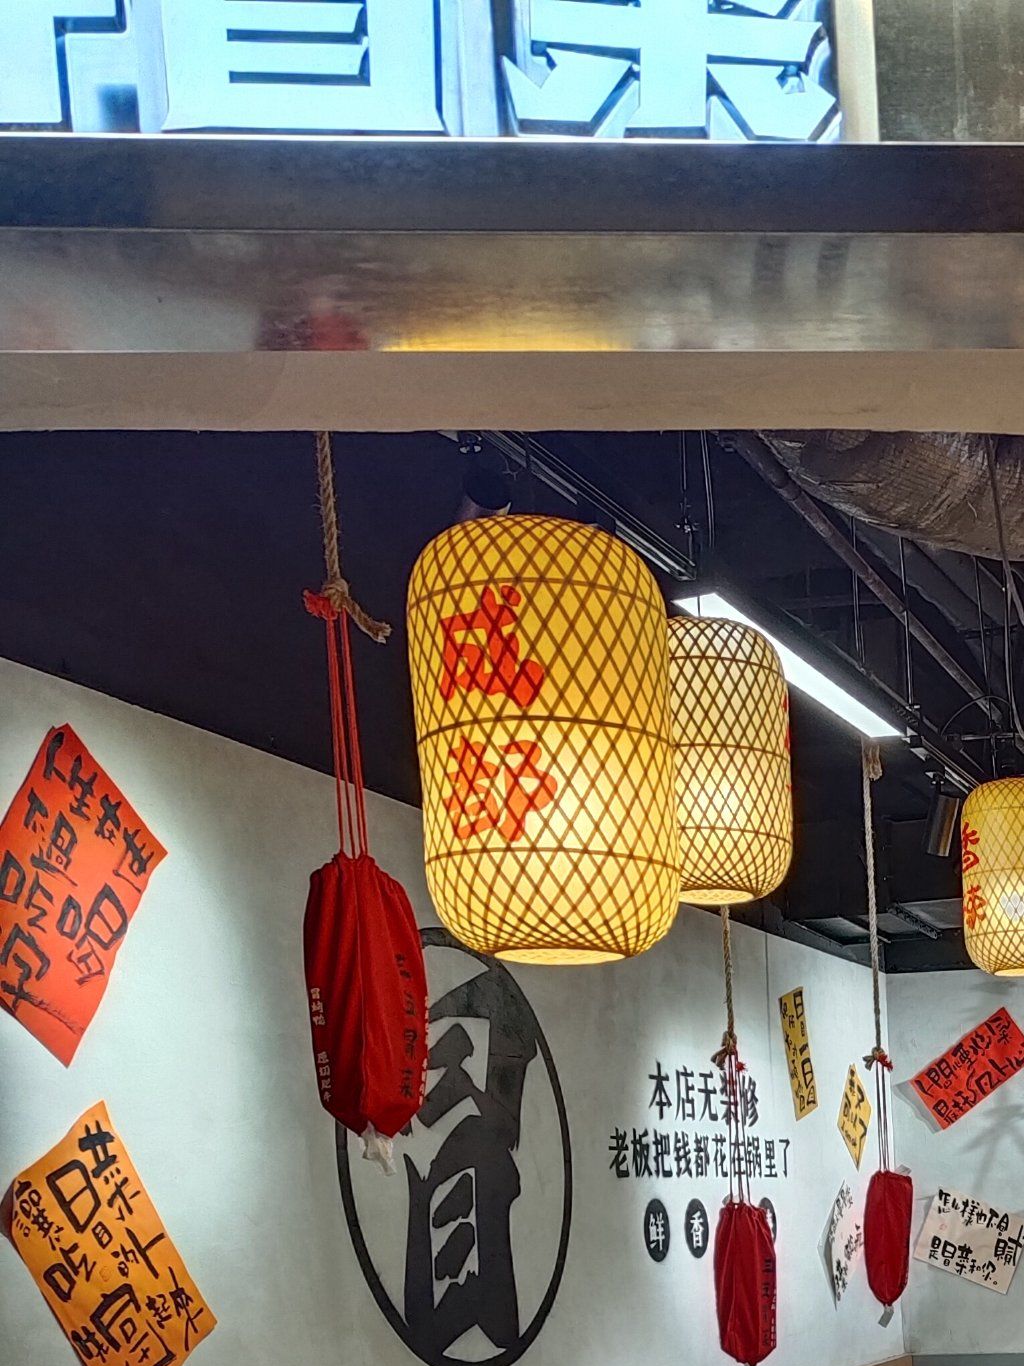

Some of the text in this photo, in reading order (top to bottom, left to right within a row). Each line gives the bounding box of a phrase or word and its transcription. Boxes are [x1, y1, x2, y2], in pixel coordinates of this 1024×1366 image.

[438, 584, 558, 842] 成都
[648, 1060, 759, 1128] 本店无装修
[608, 1126, 790, 1179] 老板把钱都花在锅里了
[649, 1213, 666, 1251] 鲜
[690, 1212, 705, 1249] 香
